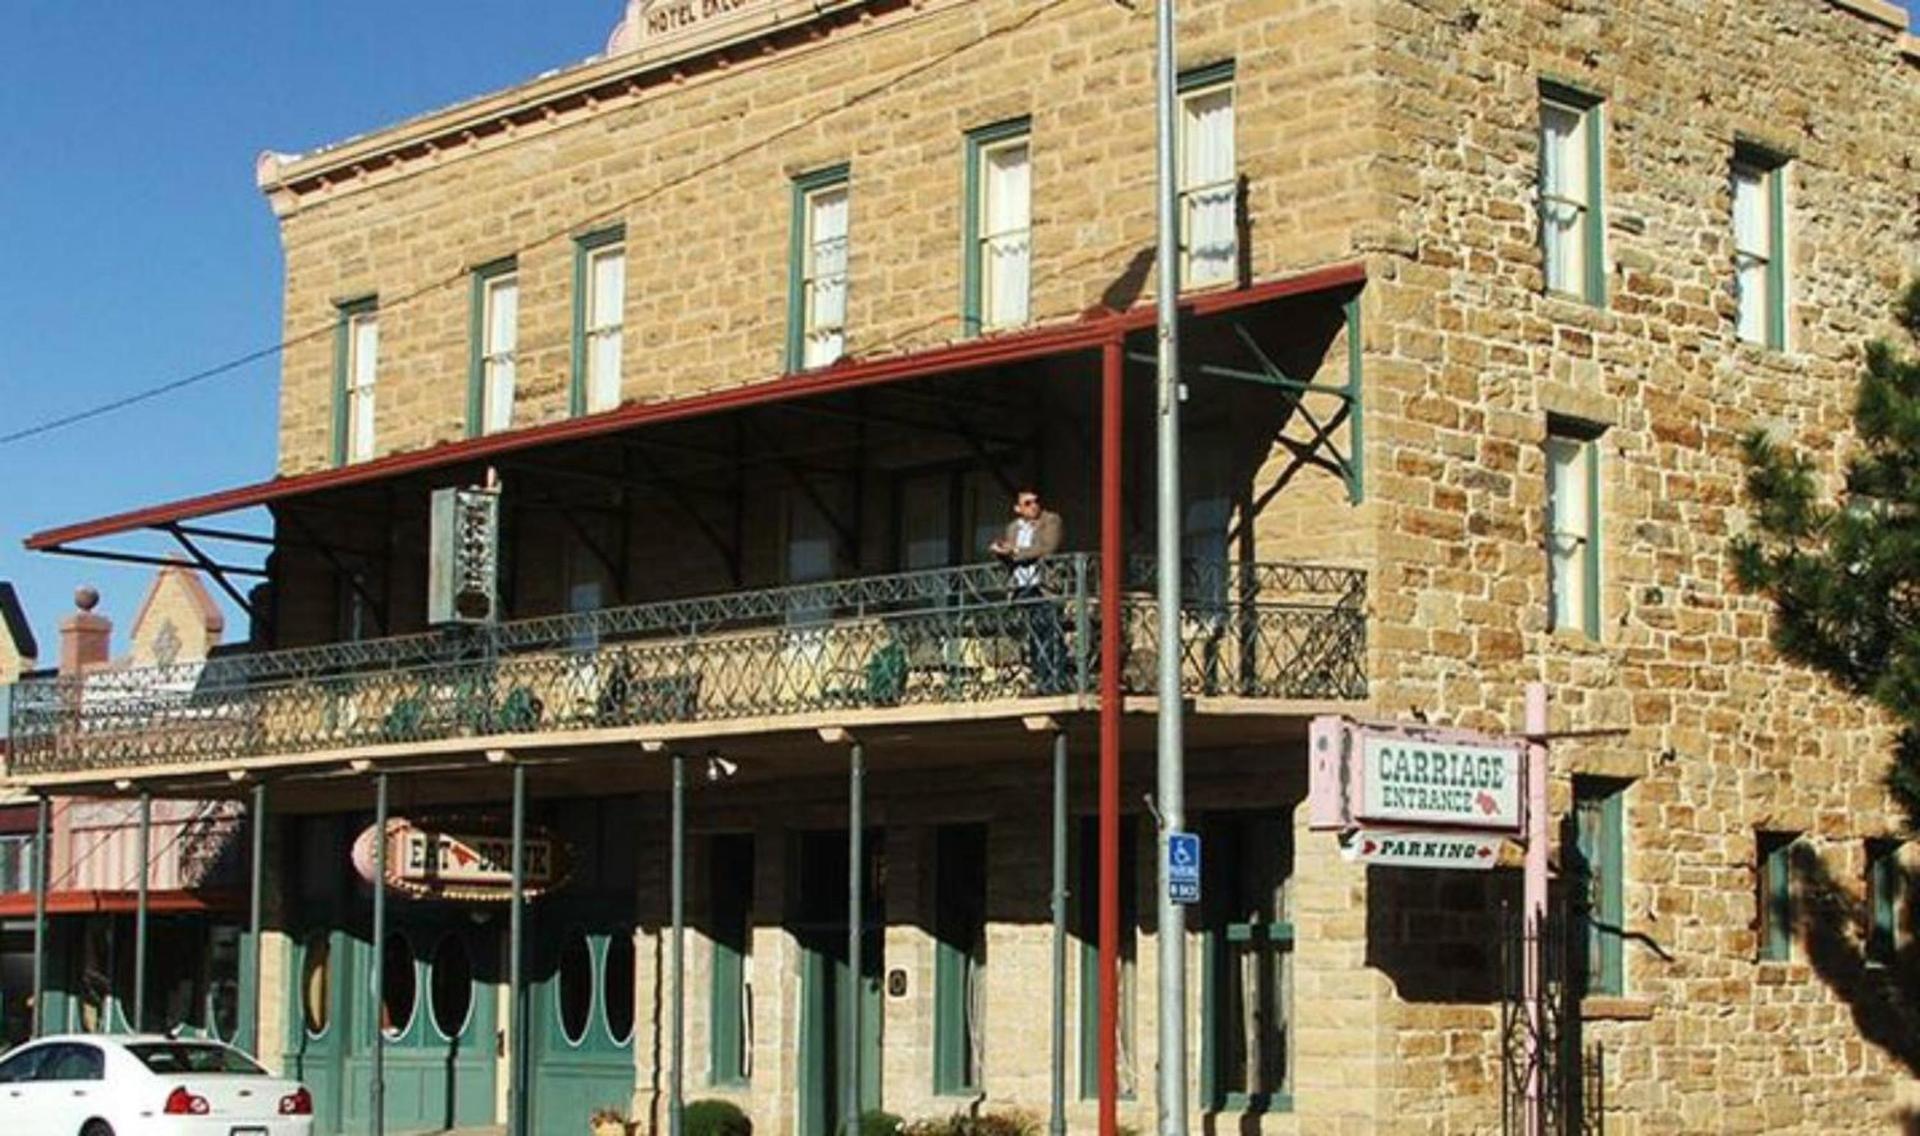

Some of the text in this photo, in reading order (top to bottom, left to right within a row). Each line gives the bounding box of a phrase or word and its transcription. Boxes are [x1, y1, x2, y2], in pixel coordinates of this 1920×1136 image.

[647, 4, 696, 35] HOTEL
[1379, 748, 1503, 789] CARRIAGE
[1382, 785, 1473, 813] ENTRANCE
[410, 838, 451, 870] EAT
[1379, 840, 1477, 859] PARKING
